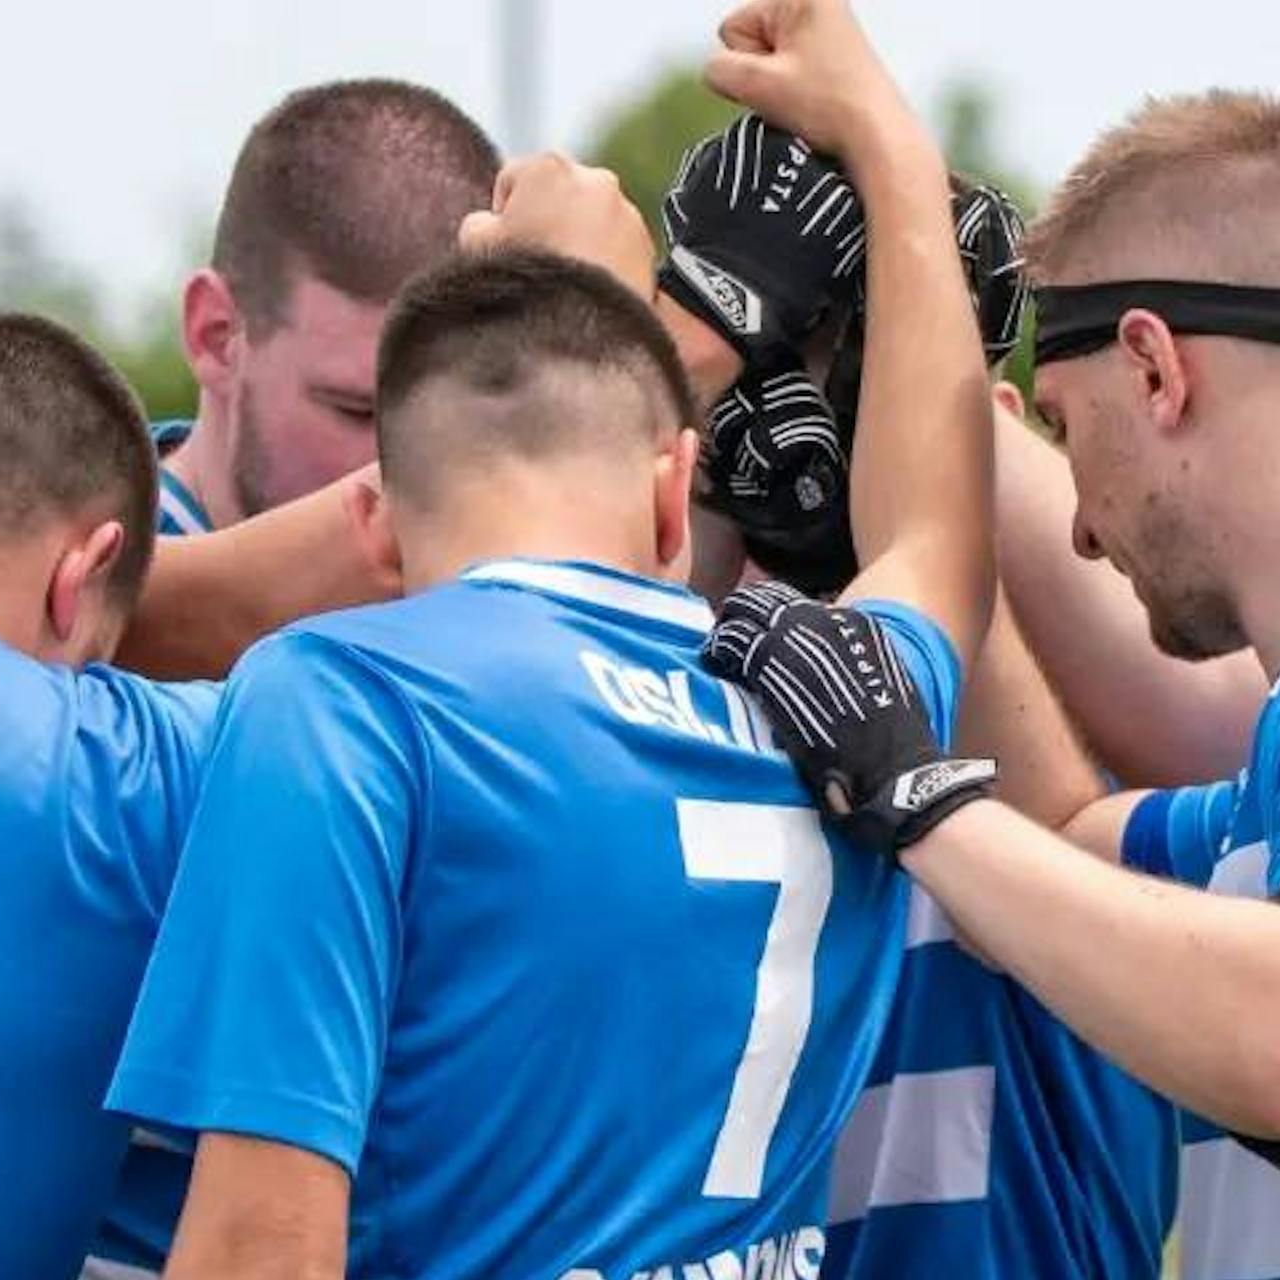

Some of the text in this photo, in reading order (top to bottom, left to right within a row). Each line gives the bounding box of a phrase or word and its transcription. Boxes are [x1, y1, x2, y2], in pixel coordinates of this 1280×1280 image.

[760, 136, 812, 213] IPSTA
[831, 613, 894, 709] KIPST
[677, 797, 834, 1199] 7
